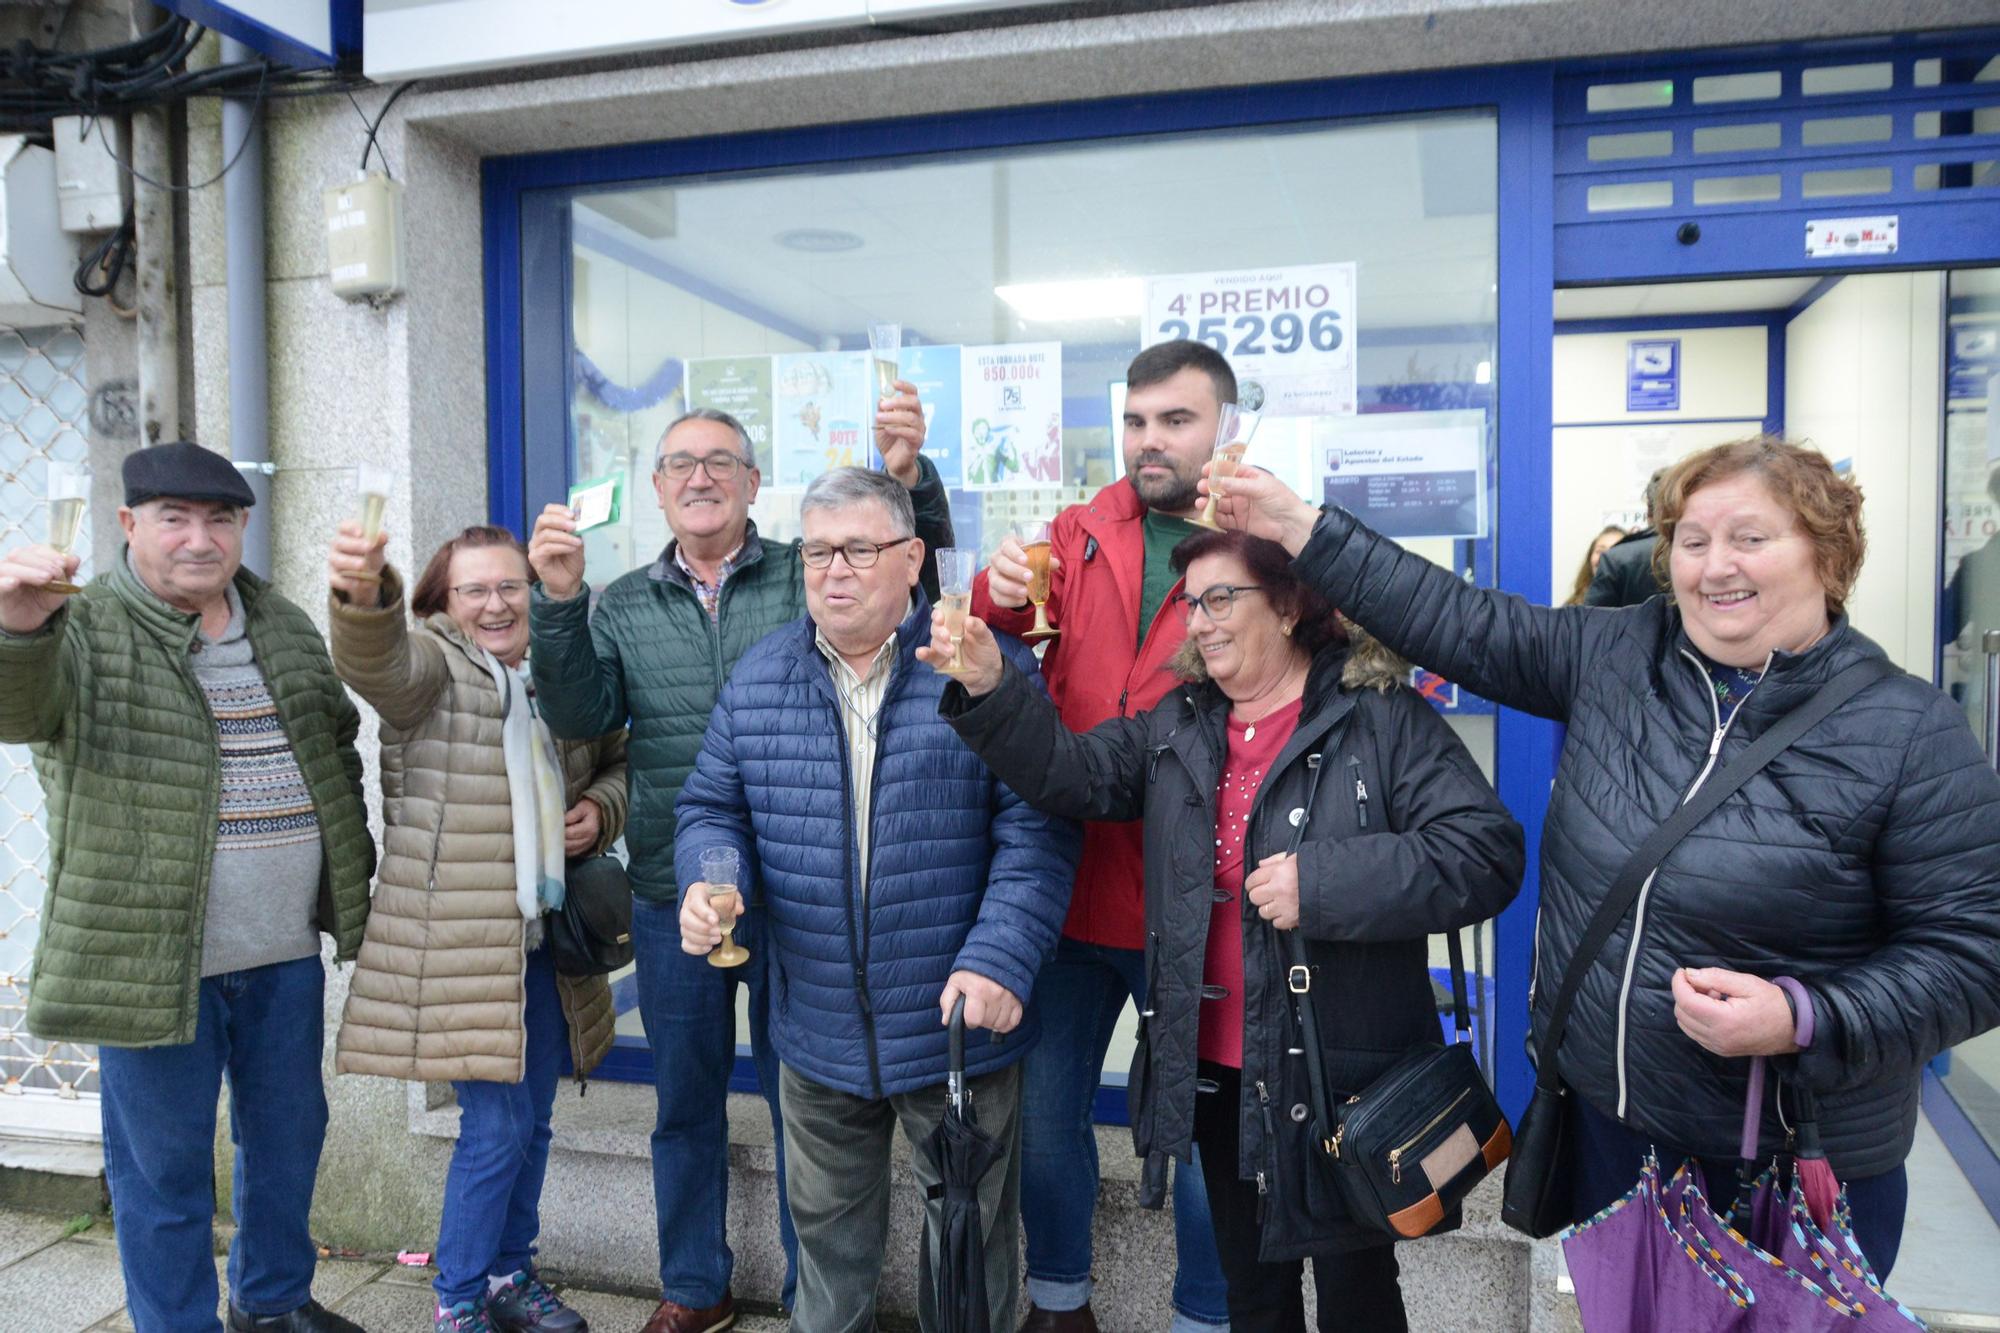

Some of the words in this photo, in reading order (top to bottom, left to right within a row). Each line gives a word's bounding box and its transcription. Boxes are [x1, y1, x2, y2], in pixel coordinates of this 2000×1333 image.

[1213, 274, 1257, 285] VENDIDO
[1199, 284, 1331, 316] PREMIO
[828, 430, 858, 446] BOTE
